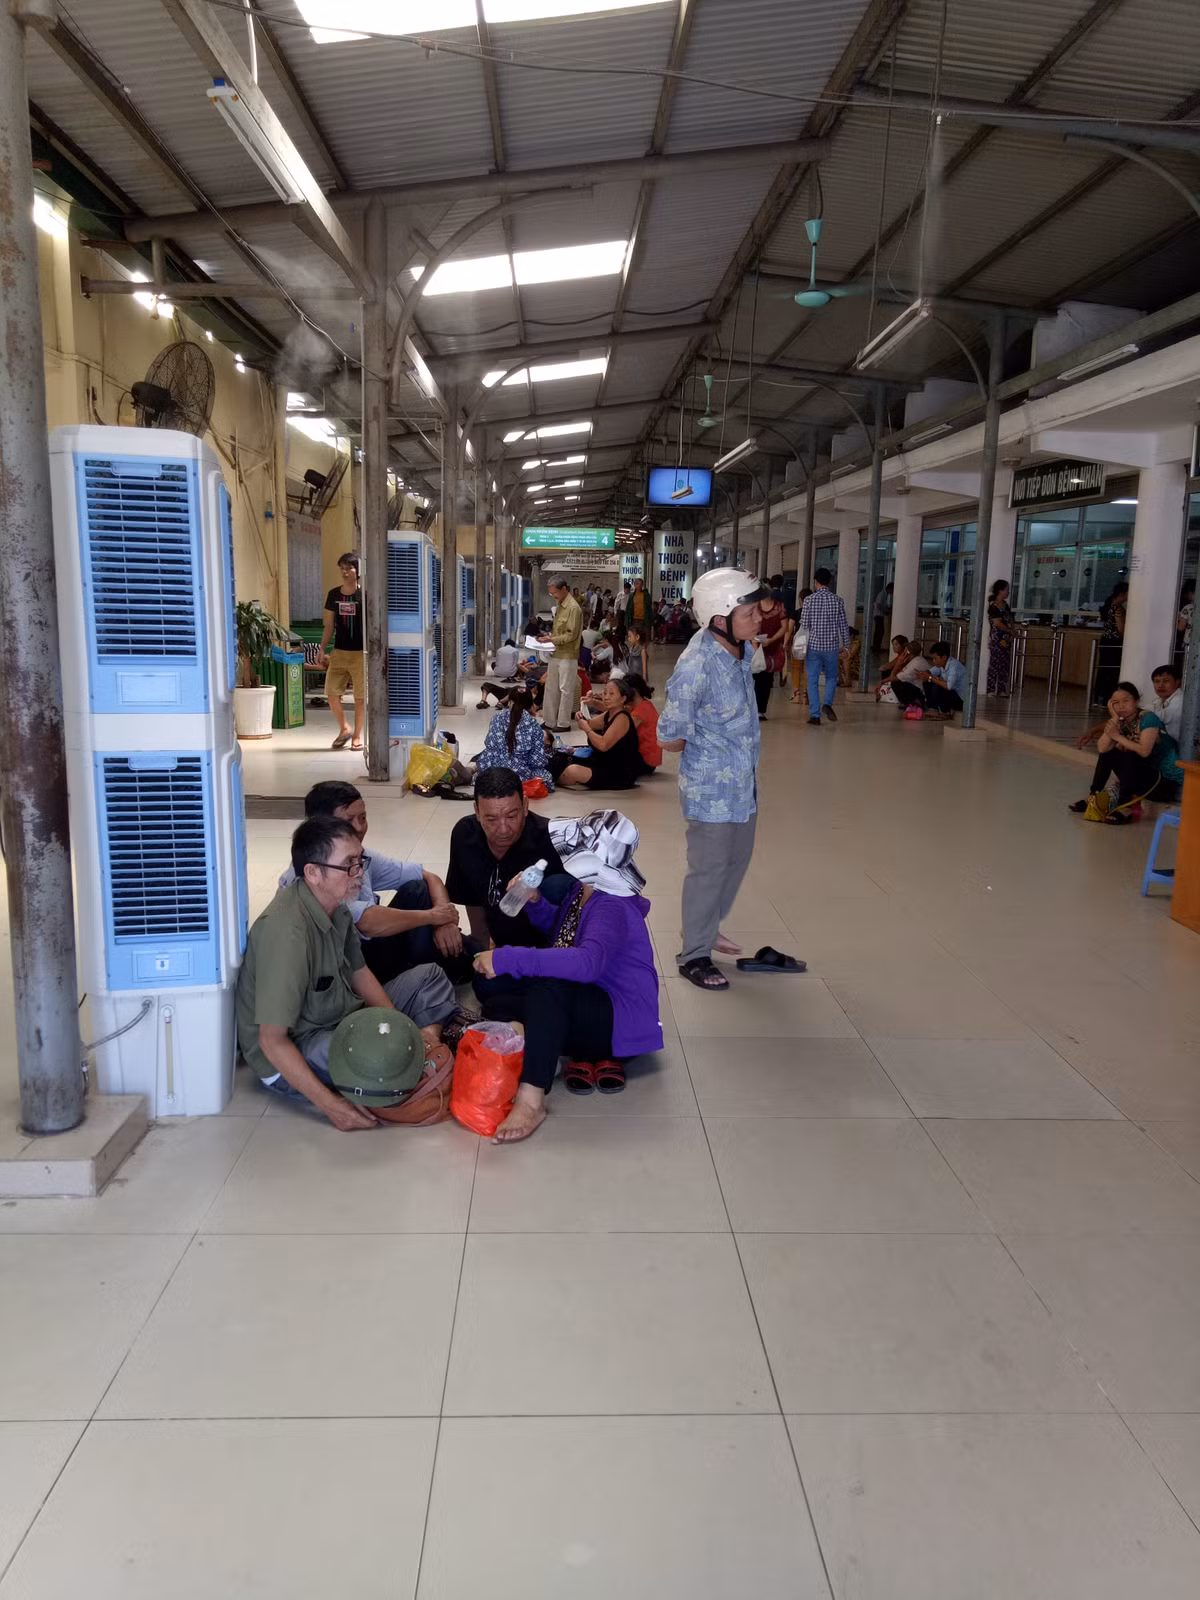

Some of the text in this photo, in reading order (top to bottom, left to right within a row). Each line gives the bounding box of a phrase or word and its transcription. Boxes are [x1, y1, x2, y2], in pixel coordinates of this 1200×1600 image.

[1027, 469, 1041, 498] TIẾP
[1041, 468, 1057, 496] ĐÓN
[1057, 465, 1079, 497] BỆNH
[601, 535, 609, 546] 4
[664, 533, 684, 547] NHÀ
[625, 554, 639, 564] NHÀ
[658, 549, 689, 565] THUỐC
[622, 565, 643, 575] THUỐC
[660, 567, 686, 584] BỆNH
[661, 585, 683, 602] VIỆN
